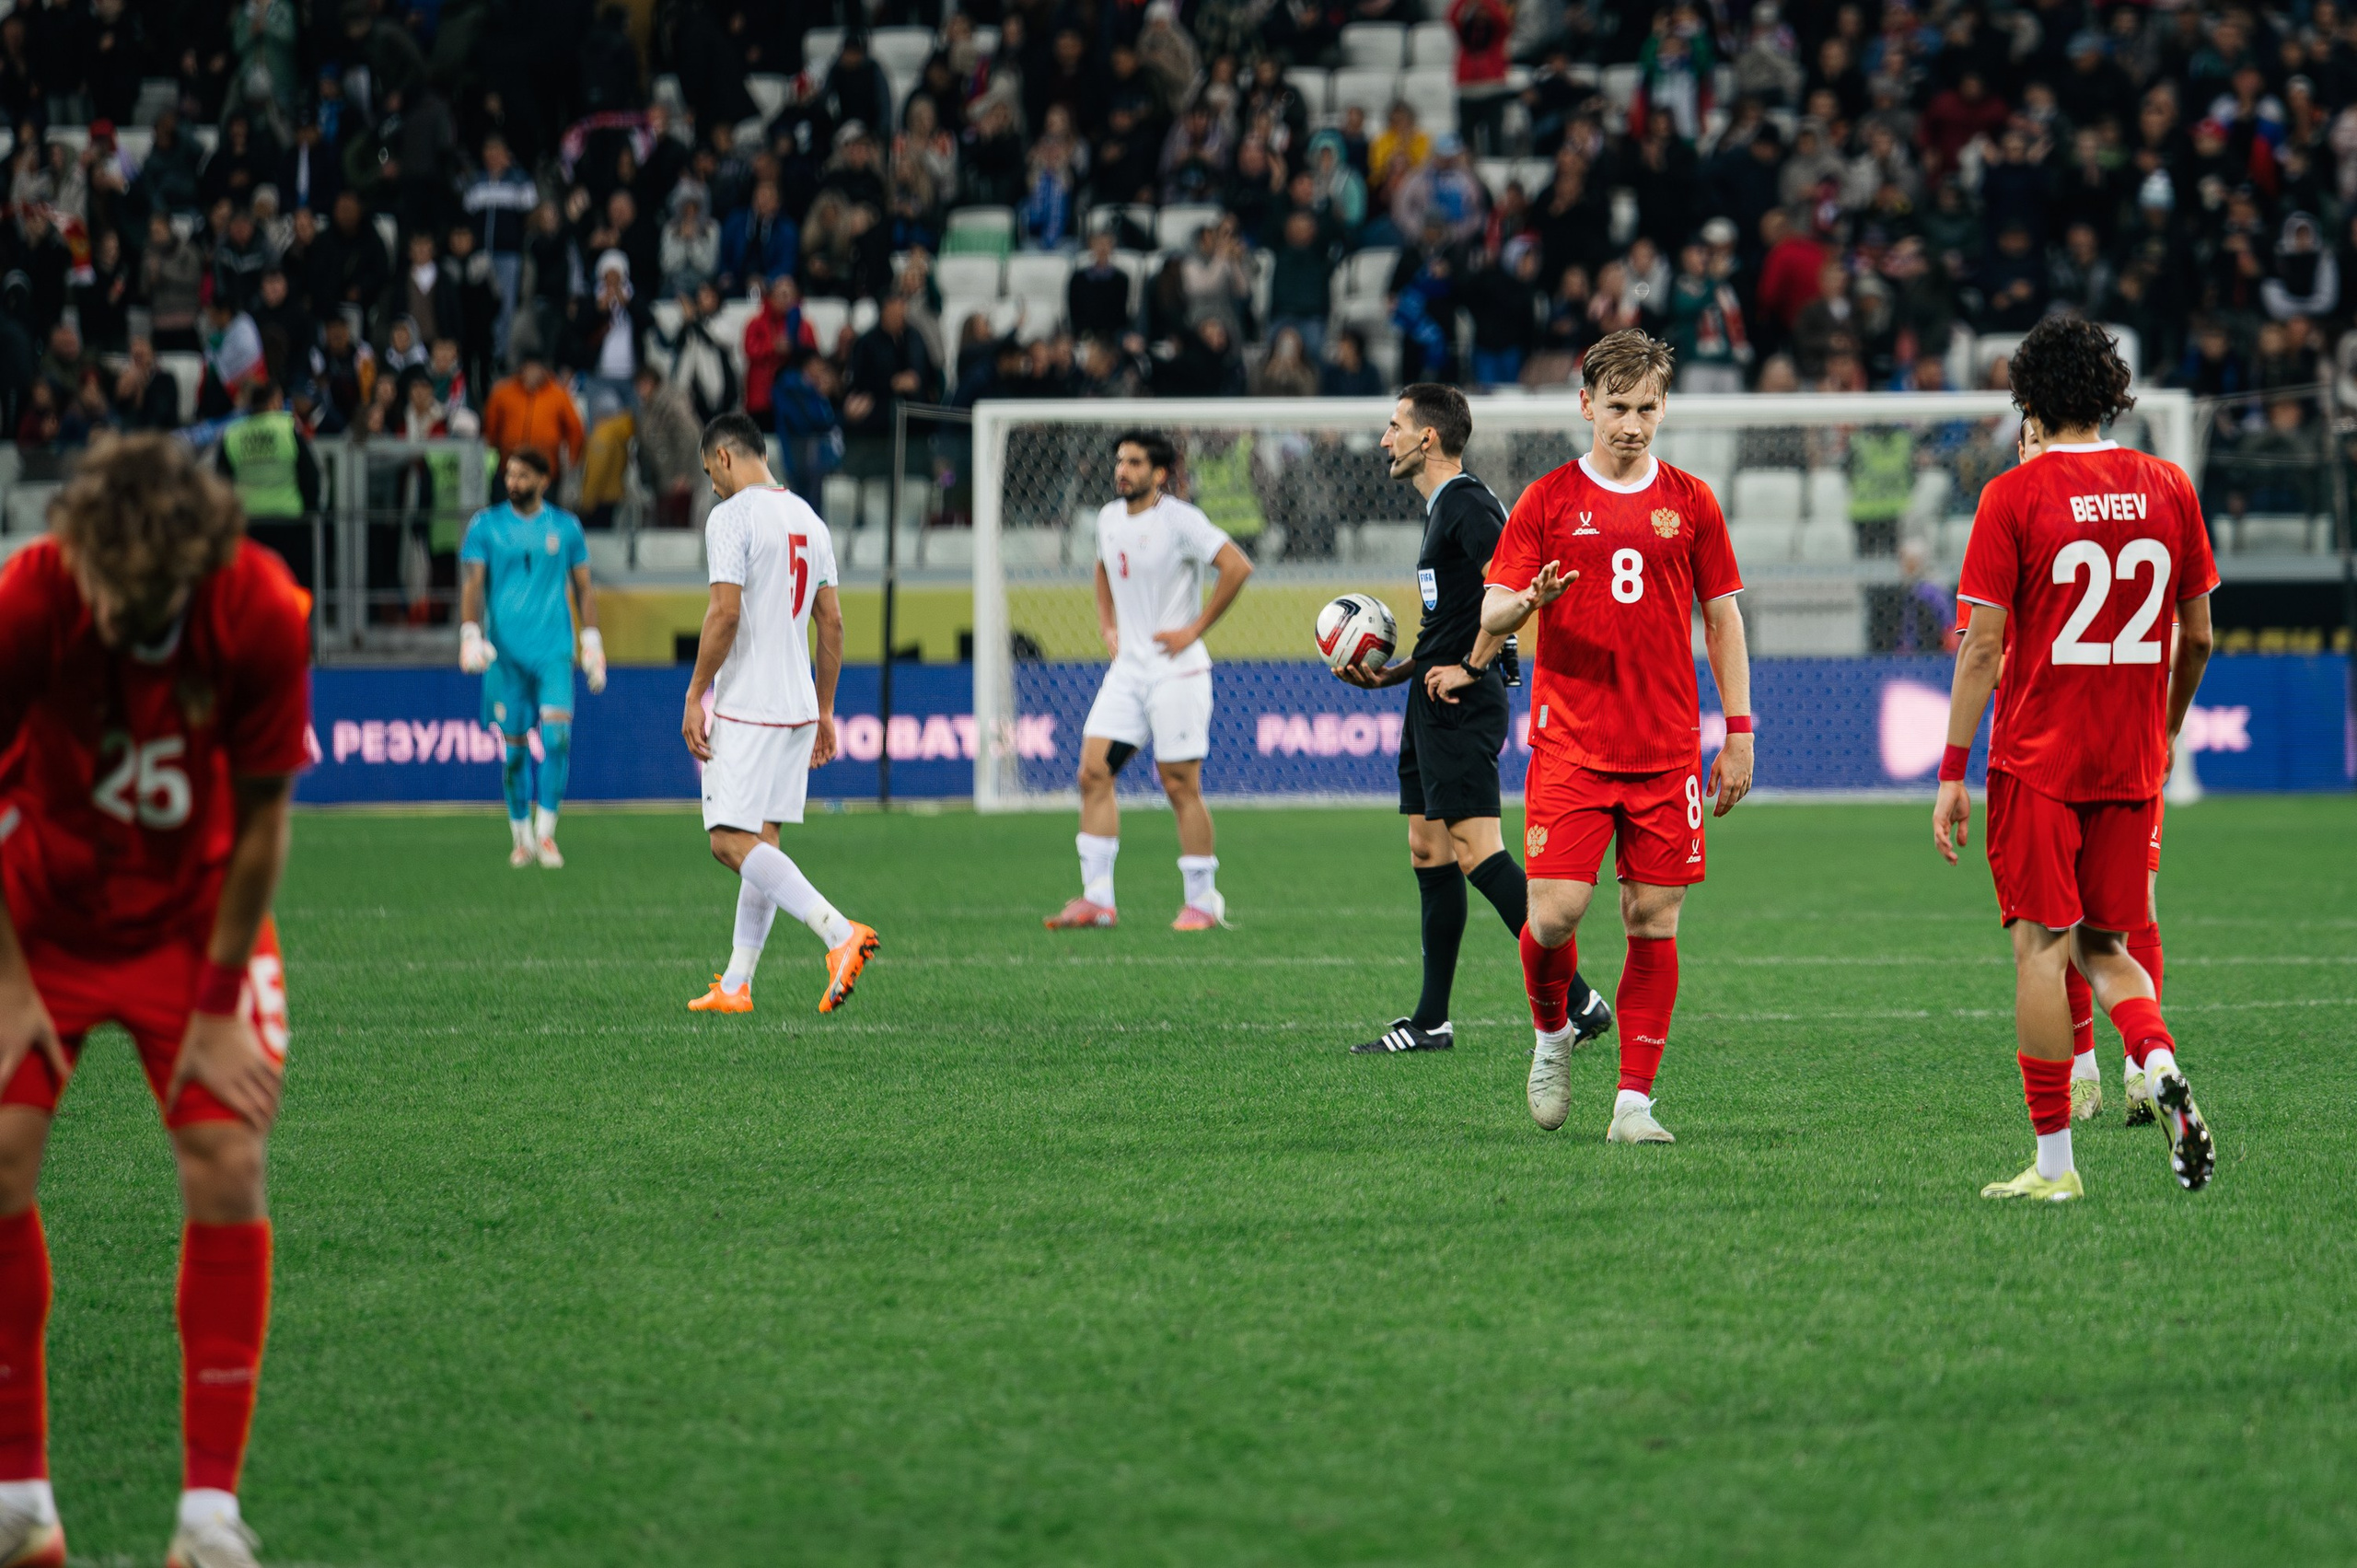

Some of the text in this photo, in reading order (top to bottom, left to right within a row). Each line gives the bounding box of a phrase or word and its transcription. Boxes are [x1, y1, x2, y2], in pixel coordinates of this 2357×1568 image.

[2070, 493, 2147, 523] BEVEEV
[788, 533, 807, 621] 5
[1420, 573, 1434, 582] FIFA
[1611, 548, 1644, 604] 8
[2051, 538, 2172, 666] 22
[1256, 713, 1404, 758] РАБОТ
[92, 736, 192, 828] 25
[1685, 774, 1701, 830] 8
